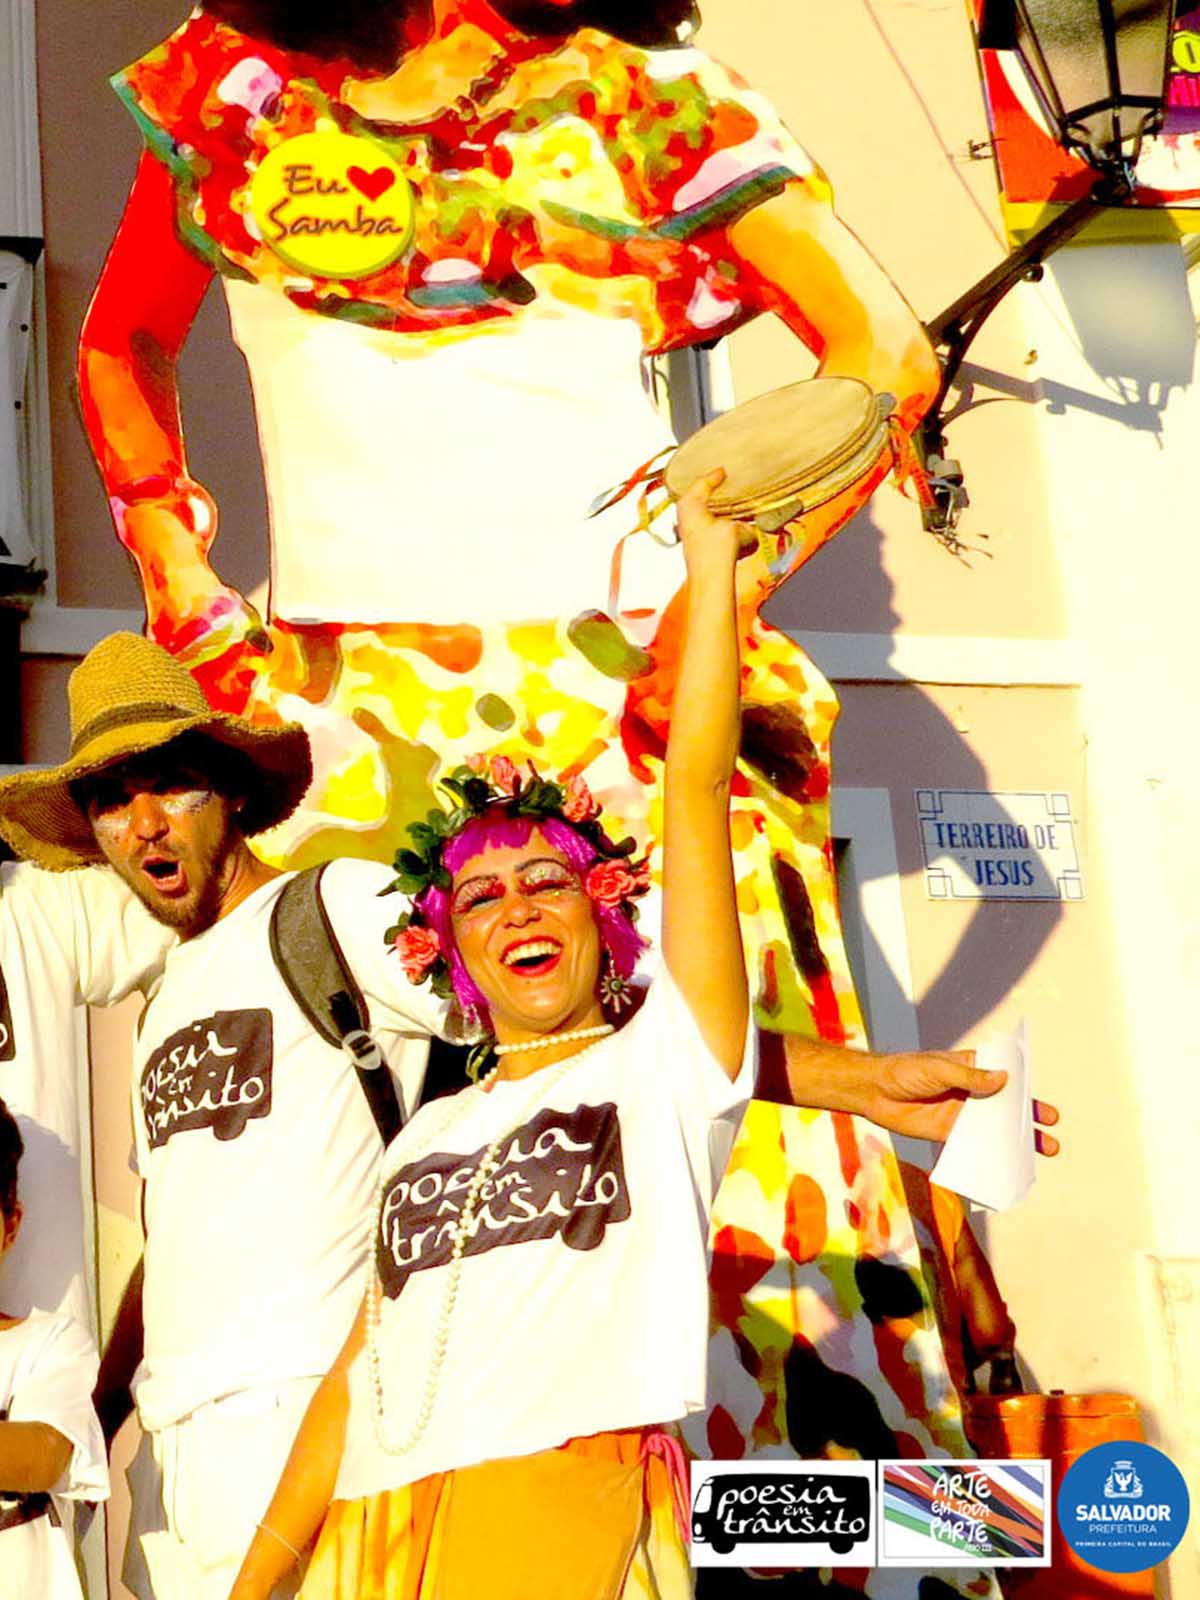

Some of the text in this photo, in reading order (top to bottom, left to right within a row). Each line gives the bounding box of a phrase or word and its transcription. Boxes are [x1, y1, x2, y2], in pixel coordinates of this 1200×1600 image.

[283, 164, 349, 194] Eu
[267, 197, 403, 241] Samba
[933, 822, 1059, 850] TERREIRO DE
[974, 859, 1036, 886] JESUS
